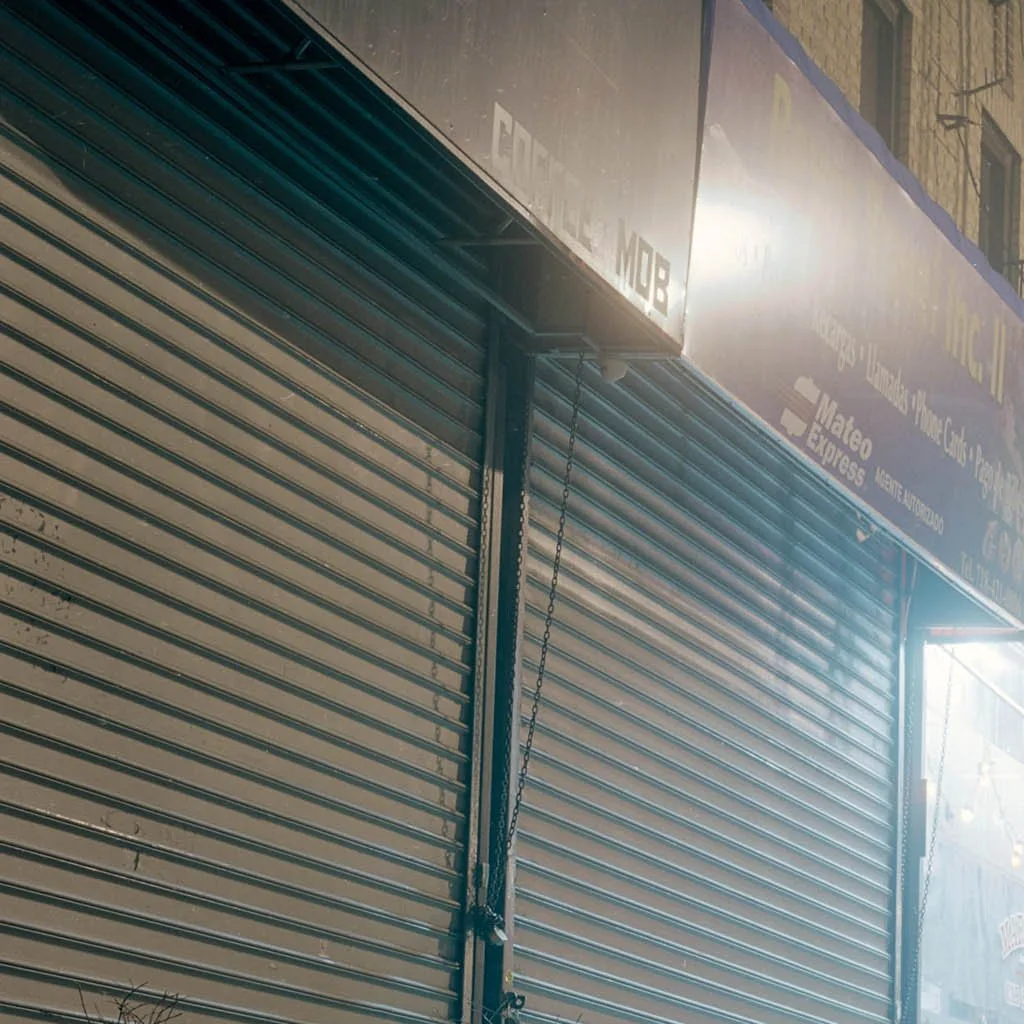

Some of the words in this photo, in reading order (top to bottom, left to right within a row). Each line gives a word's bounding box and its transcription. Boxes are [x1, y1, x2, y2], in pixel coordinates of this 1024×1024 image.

[615, 217, 671, 317] MOB
[815, 393, 873, 462] Mateo
[914, 390, 942, 445] Phone
[806, 423, 867, 488] Express
[874, 466, 903, 506] AGENTE
[902, 490, 945, 536] AUTORIZADO
